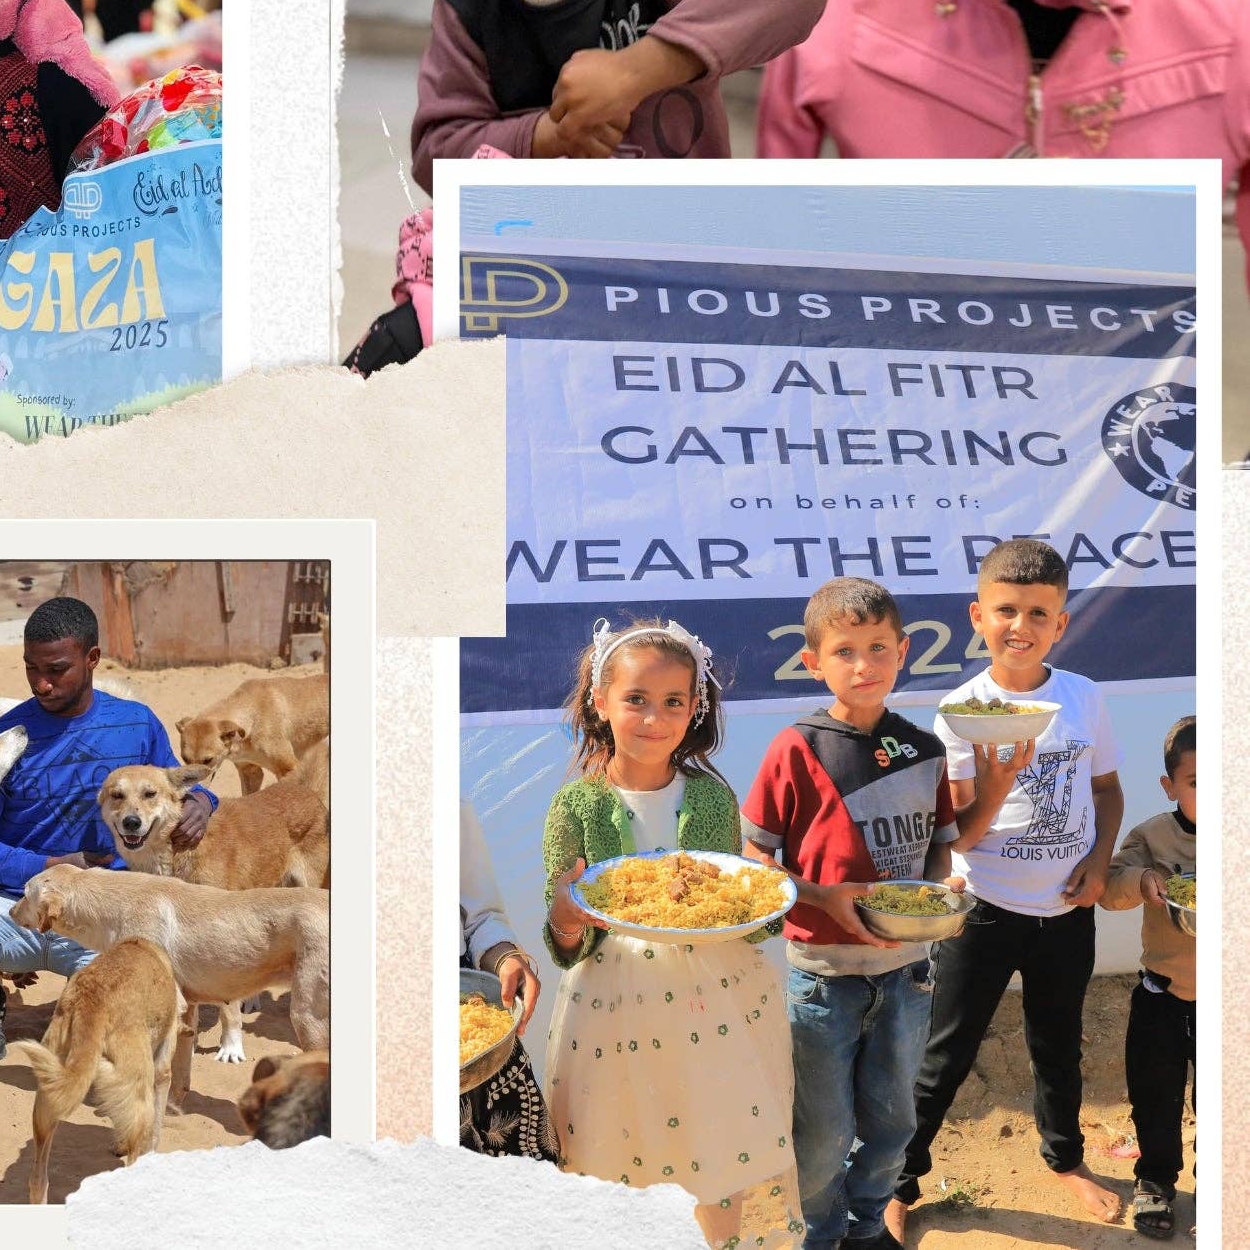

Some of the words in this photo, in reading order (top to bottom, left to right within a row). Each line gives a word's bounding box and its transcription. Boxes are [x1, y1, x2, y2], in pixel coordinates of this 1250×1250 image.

[73, 216, 141, 238] PROJECTS
[605, 285, 832, 320] PIOUS
[861, 296, 1196, 334] PROJECTS
[110, 320, 169, 352] 2025
[612, 353, 746, 393] EID
[771, 358, 867, 397] AL
[887, 363, 1040, 400] FITR
[16, 394, 60, 407] Sponsored
[1107, 385, 1175, 437] WEAR
[600, 425, 1068, 467] GATHERING
[729, 495, 774, 511] on
[795, 493, 917, 511] behalf
[936, 493, 981, 510] of:
[506, 536, 753, 584] WEAR
[774, 535, 938, 580] THE
[961, 530, 1196, 575] PACE
[1000, 846, 1043, 861] LOUIS
